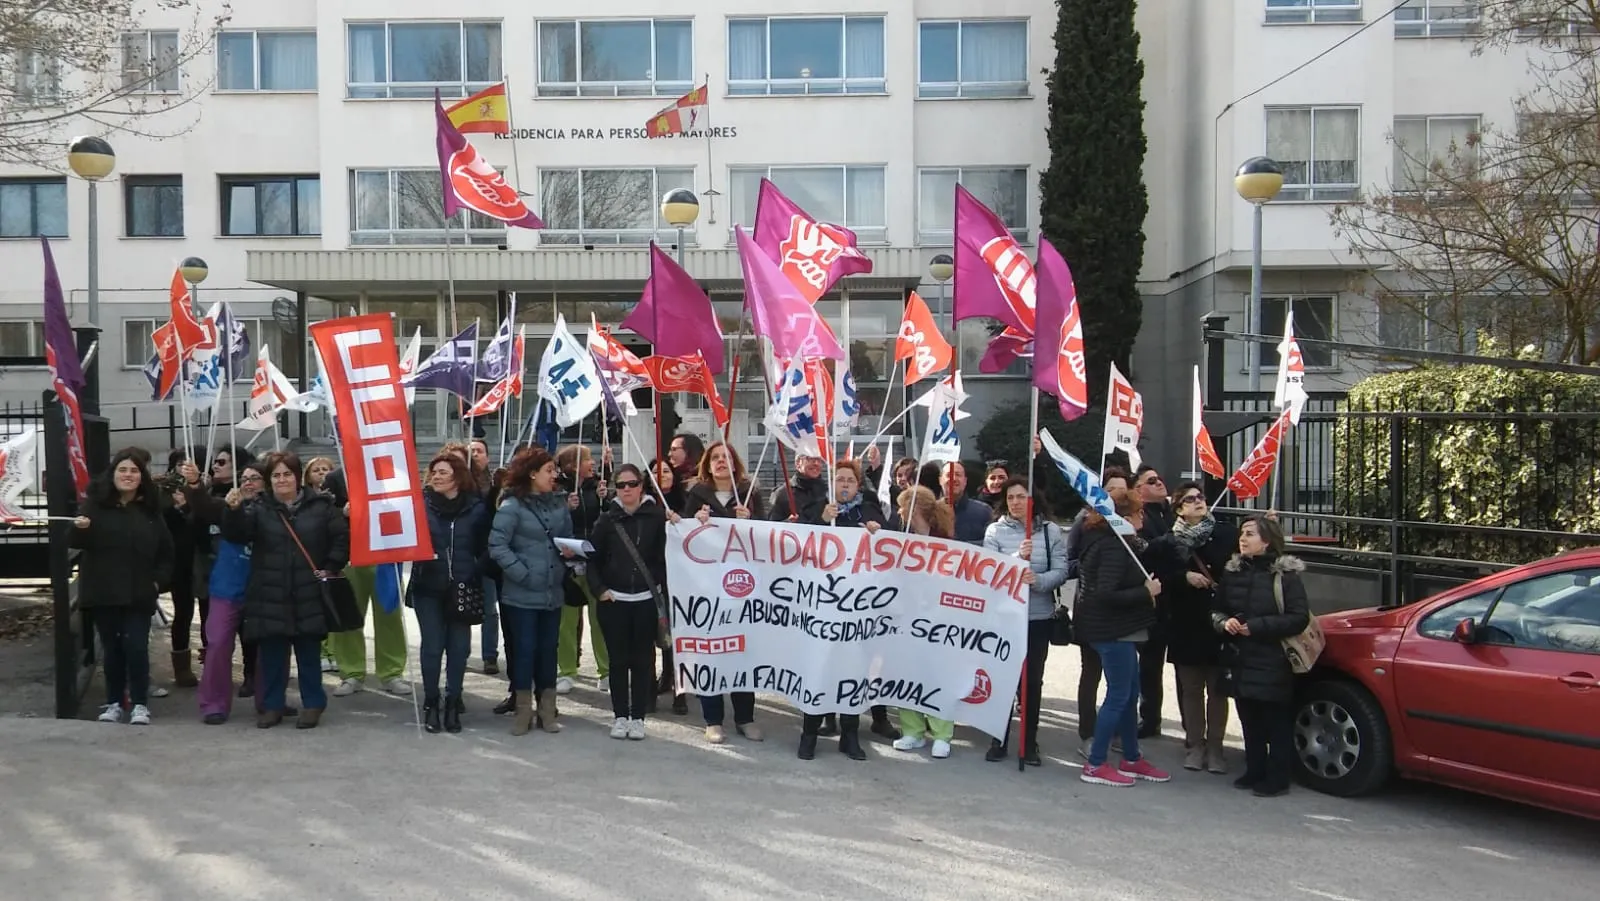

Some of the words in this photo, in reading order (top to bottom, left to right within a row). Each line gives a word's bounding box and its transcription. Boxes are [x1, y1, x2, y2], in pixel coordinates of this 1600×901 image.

[571, 128, 604, 140] PARA
[679, 127, 737, 138] MAYORES
[333, 328, 418, 551] CCOO
[727, 573, 750, 584] UGT
[769, 576, 898, 612] EMPLEO
[942, 593, 983, 610] CCOO
[719, 609, 732, 626] AL
[739, 599, 789, 627] ABUSO
[910, 618, 1011, 662] SERVICIO
[681, 637, 740, 654] CCOO
[719, 675, 728, 690] A
[733, 671, 746, 688] LA
[753, 665, 803, 701] FALTA
[803, 689, 826, 707] DE
[836, 677, 942, 712] PERSONAL
